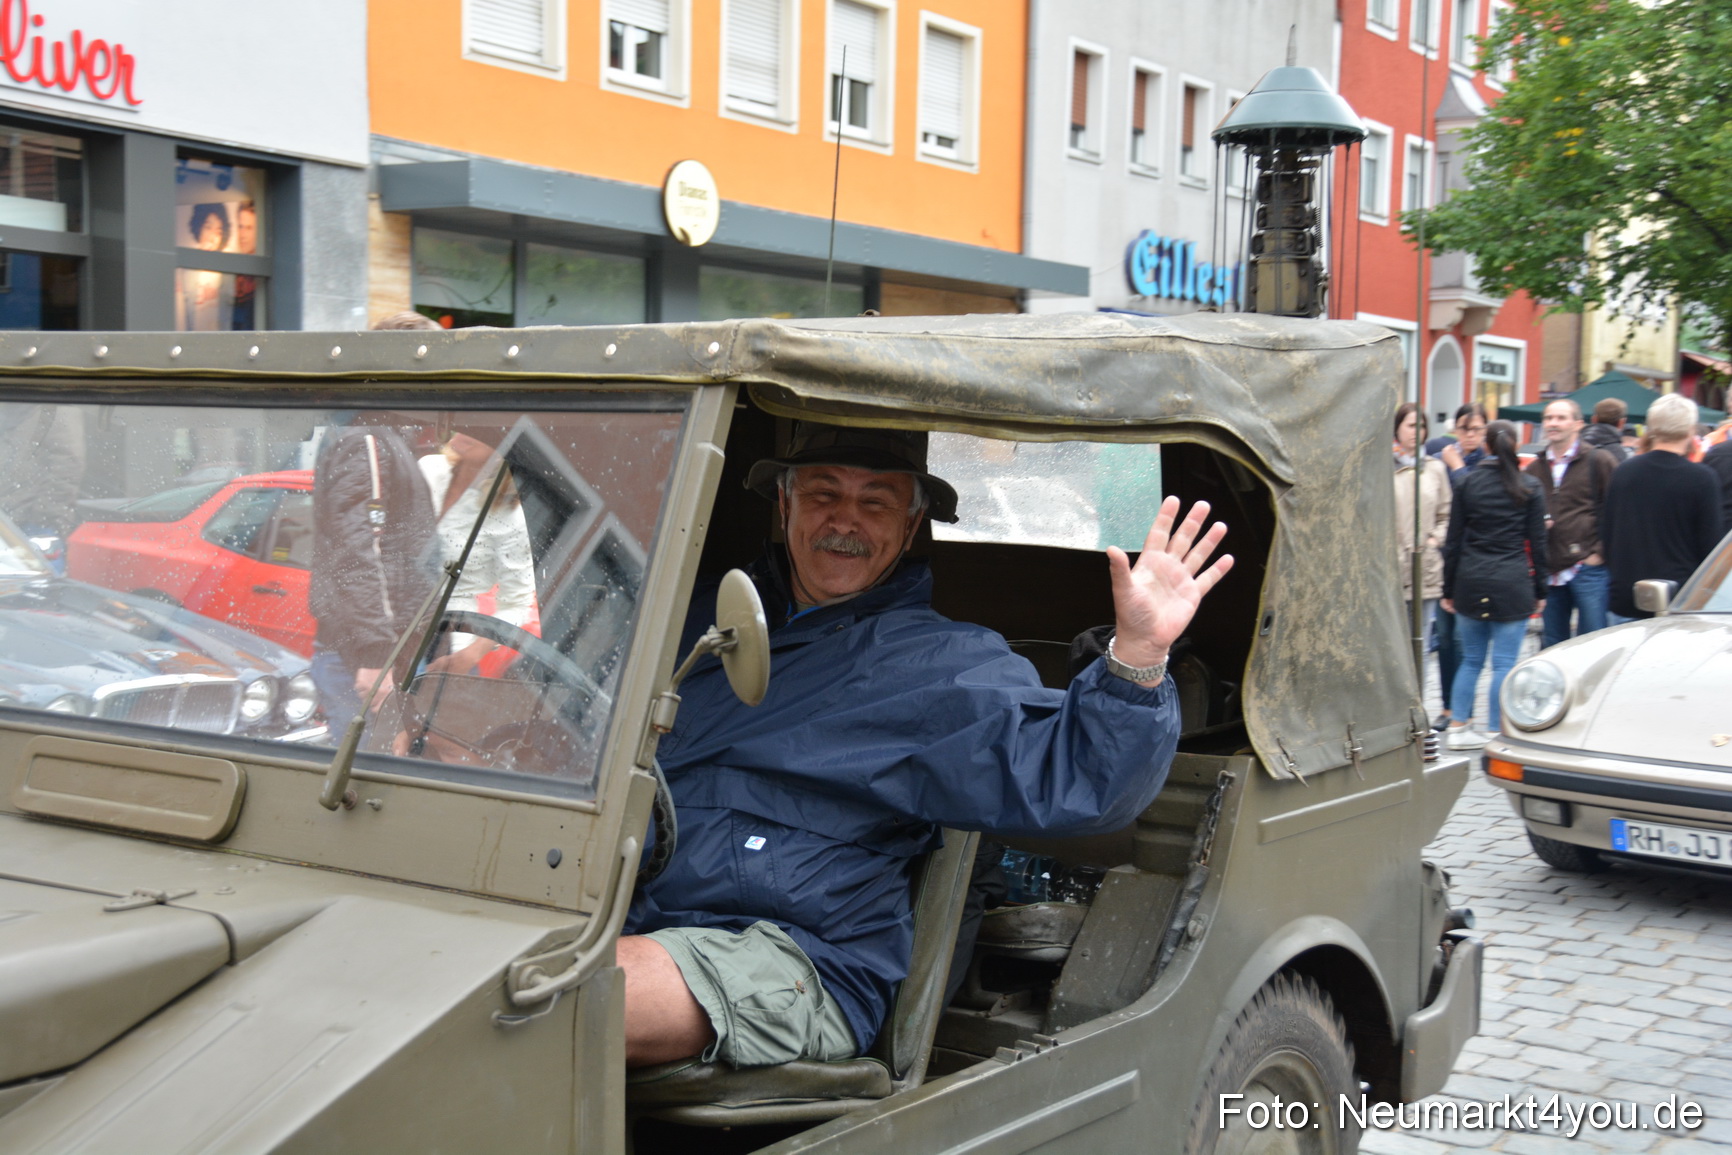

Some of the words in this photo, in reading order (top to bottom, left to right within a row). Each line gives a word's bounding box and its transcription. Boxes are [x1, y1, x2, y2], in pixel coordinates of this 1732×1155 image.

[0, 0, 143, 106] liver
[1627, 825, 1665, 853] RH
[1684, 832, 1721, 860] JJ
